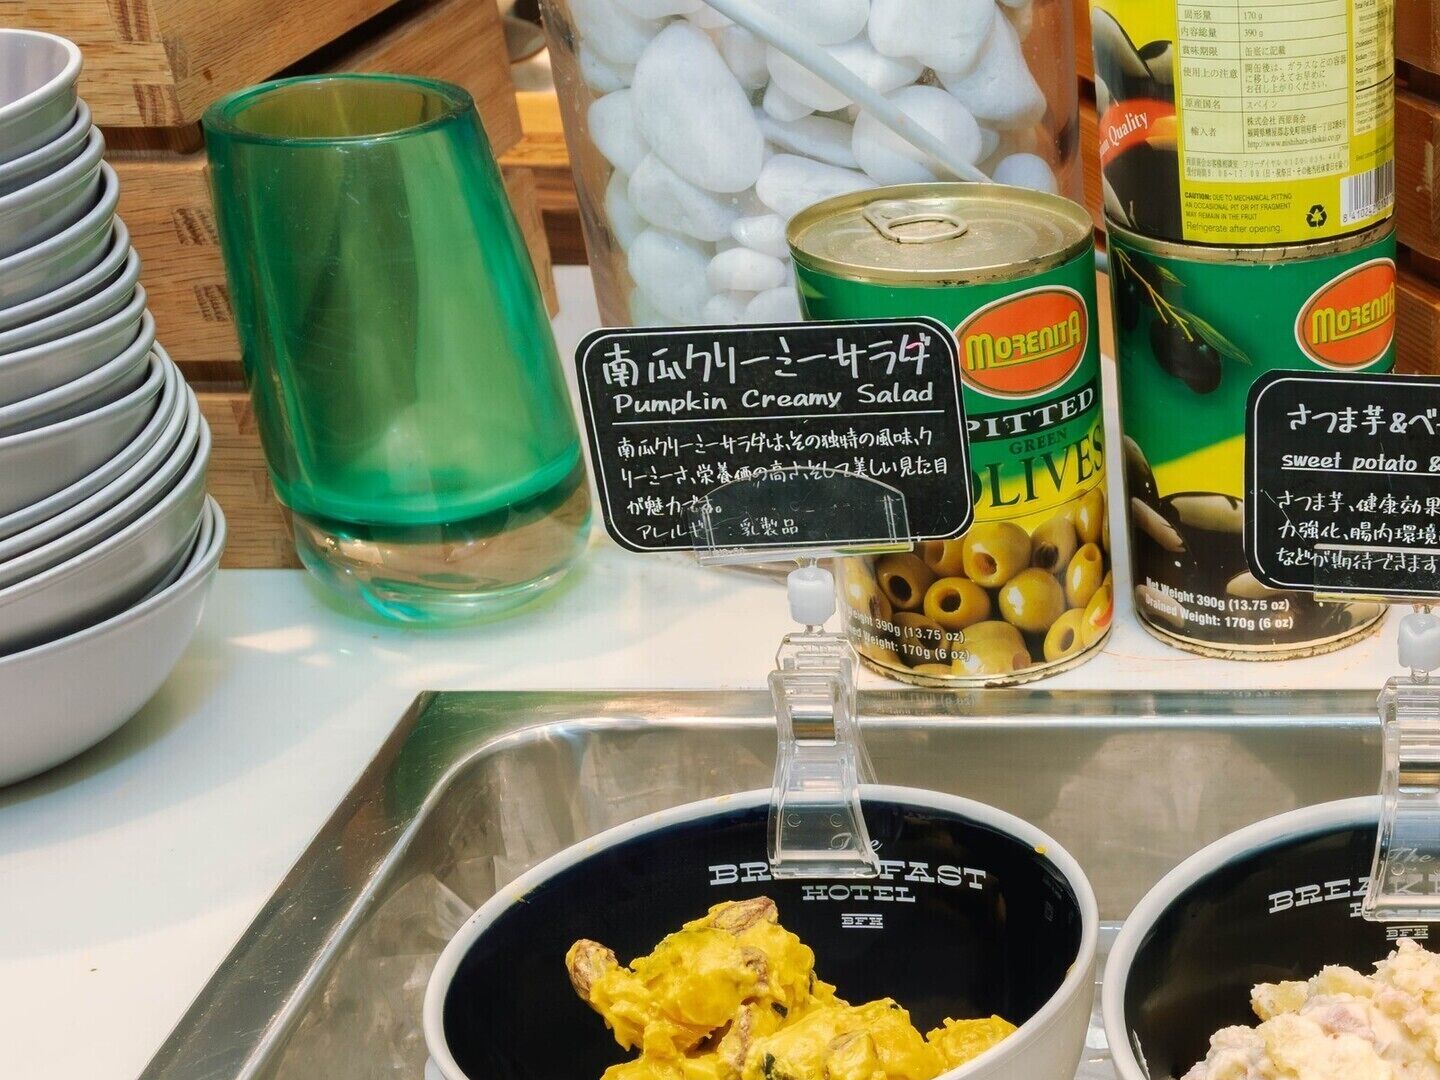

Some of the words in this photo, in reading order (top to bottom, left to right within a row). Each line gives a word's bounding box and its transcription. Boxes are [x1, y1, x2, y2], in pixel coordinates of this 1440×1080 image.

[1243, 10, 1256, 20] 170
[1108, 112, 1148, 146] Quality
[1186, 221, 1228, 234] Refrigerate
[1229, 222, 1247, 233] after
[966, 311, 1081, 371] MORENITA
[602, 333, 931, 388] 南瓜クリーミーサラダ
[613, 391, 728, 415] Pumpkin
[742, 387, 843, 410] Creamy
[858, 382, 934, 404] Salad
[1008, 428, 1068, 455] GREEN
[1282, 451, 1342, 469] sweet
[1352, 451, 1418, 473] potato
[1160, 584, 1195, 605] Weight
[1196, 595, 1226, 612] 390g
[1228, 599, 1268, 613] (13.75
[1270, 598, 1291, 613] oz)
[875, 618, 901, 638] 390g
[904, 626, 941, 641] (13.75
[1180, 606, 1222, 628] Weight:
[1224, 616, 1255, 631] 170g
[1258, 617, 1273, 631] (6
[1274, 616, 1294, 631] oz)
[863, 630, 899, 652] Weight:
[902, 643, 931, 660] 170g
[935, 648, 947, 660] (6
[708, 860, 987, 890] BRFAST
[801, 884, 916, 903] HOTEL
[841, 915, 884, 928] BFH
[1386, 927, 1429, 939] BFH
